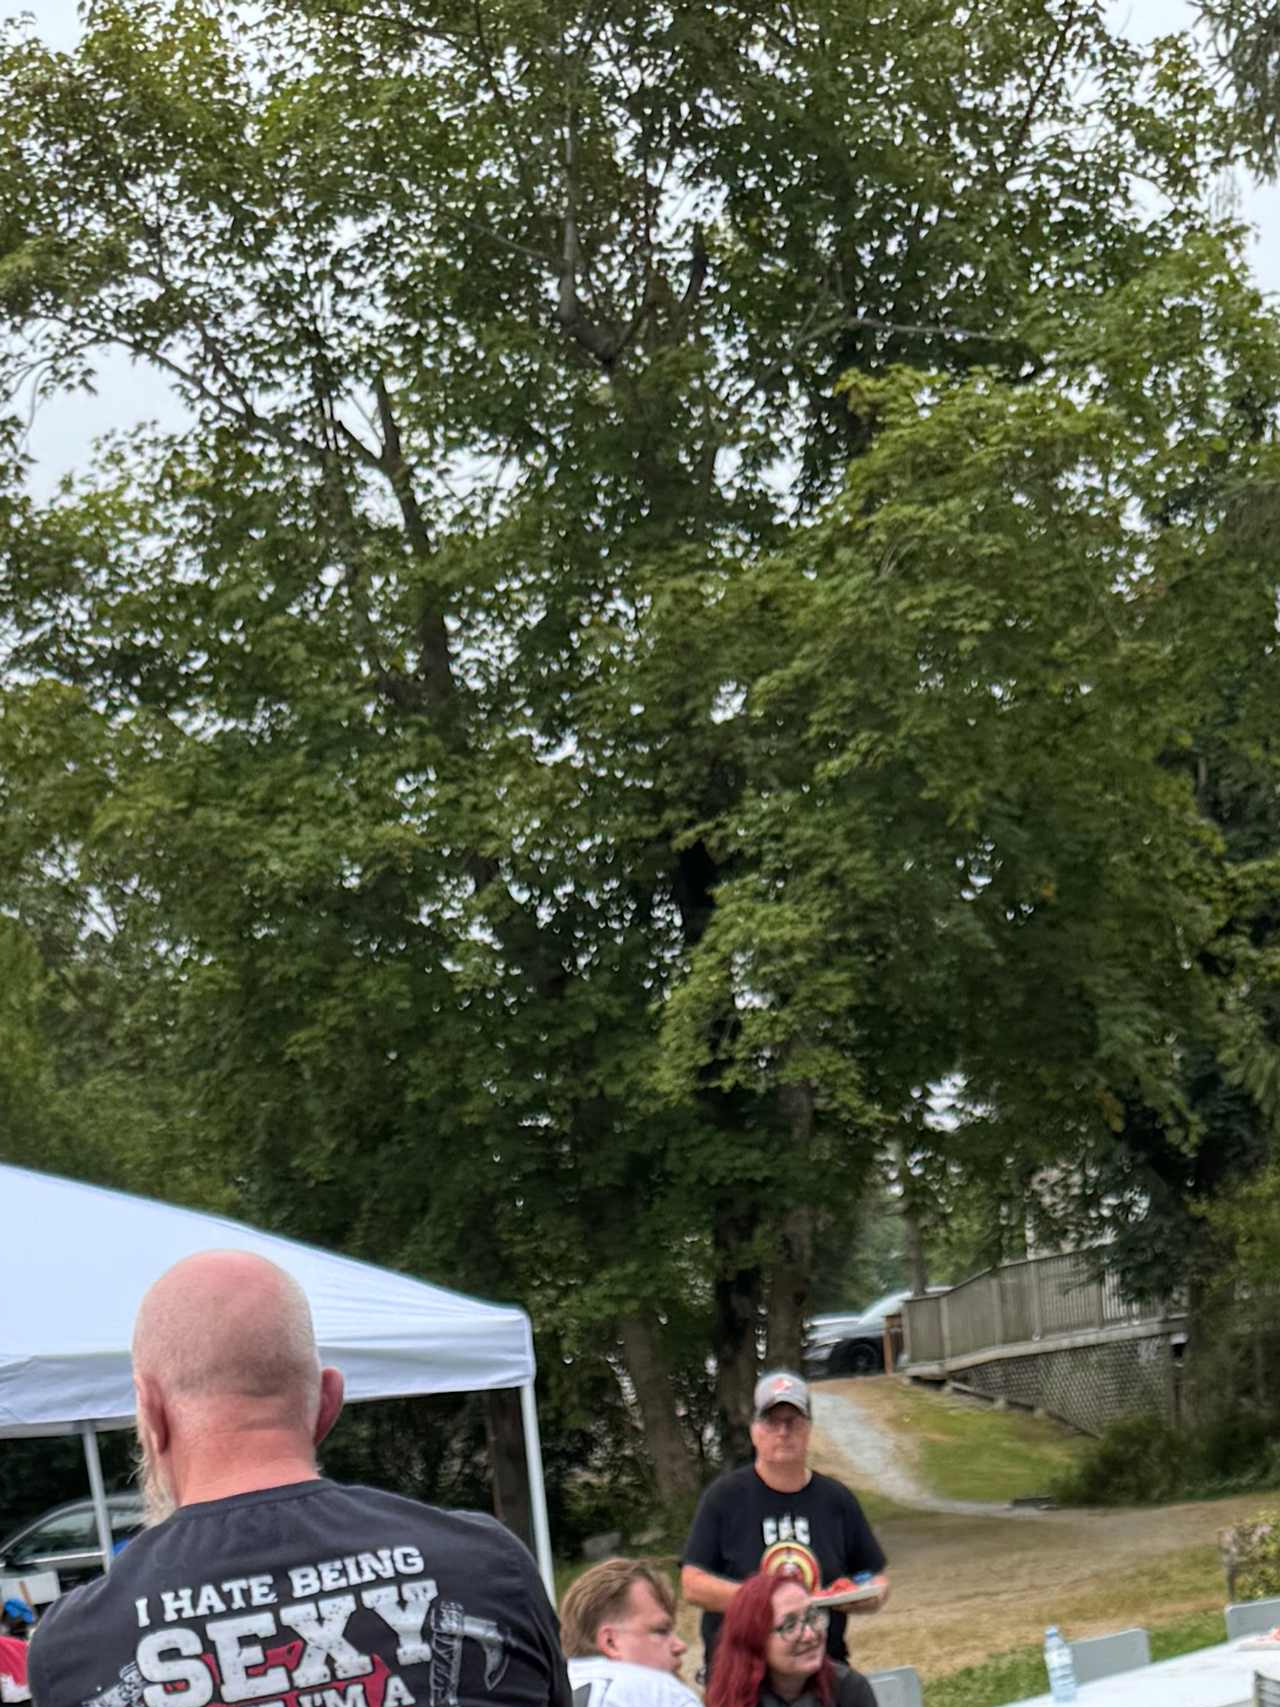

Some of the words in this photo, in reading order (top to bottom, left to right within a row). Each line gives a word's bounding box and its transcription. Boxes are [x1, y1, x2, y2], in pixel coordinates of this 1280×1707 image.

[134, 1597, 151, 1628] I
[160, 1574, 279, 1624] HATE
[287, 1545, 425, 1599] BEING
